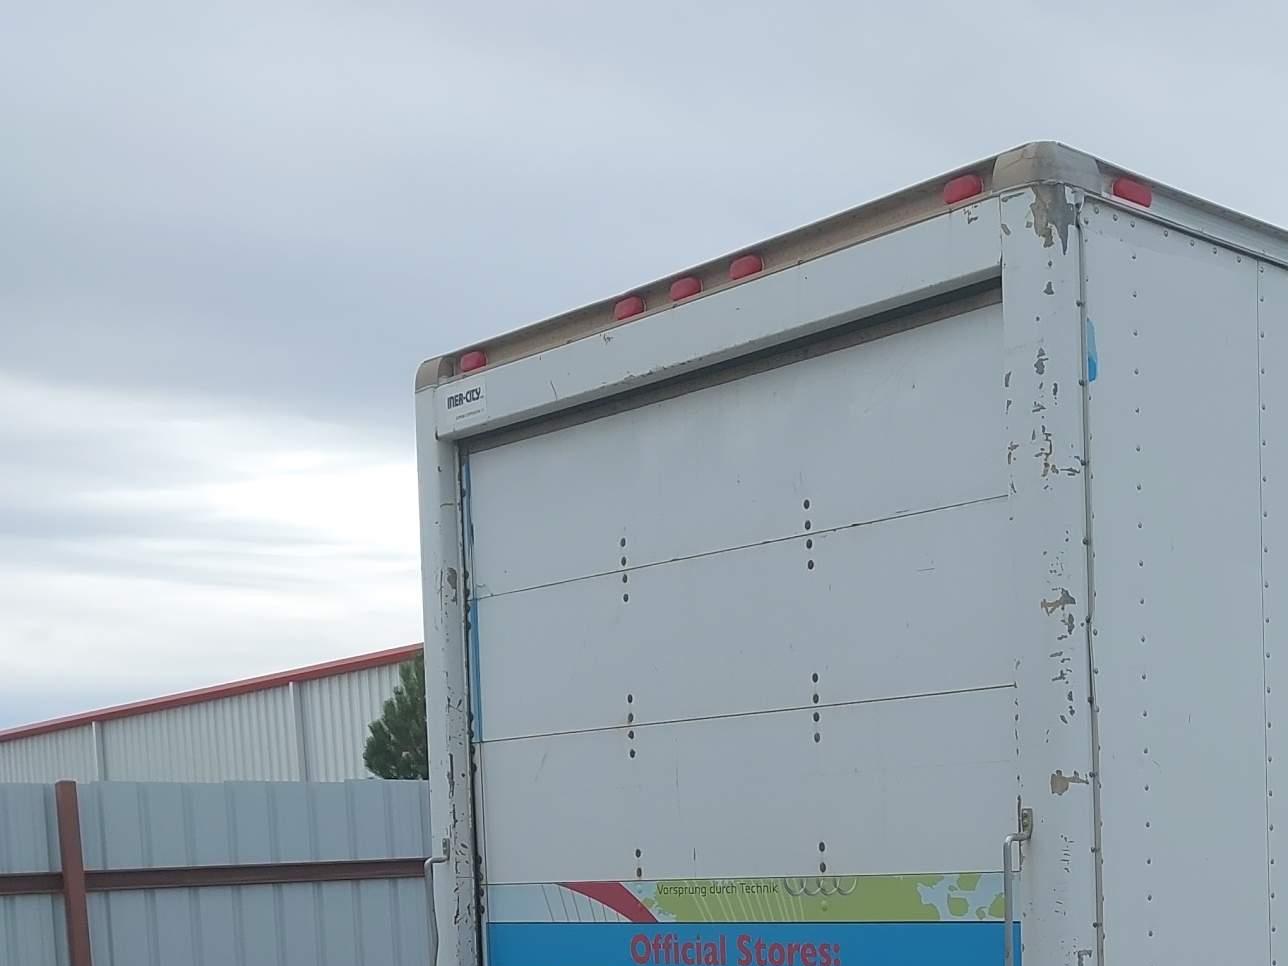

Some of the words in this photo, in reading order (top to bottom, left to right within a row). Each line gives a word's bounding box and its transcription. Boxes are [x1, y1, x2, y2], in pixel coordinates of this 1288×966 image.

[657, 884, 707, 897] Vorsprung
[710, 883, 737, 895] durch
[740, 882, 779, 895] Technik
[631, 934, 727, 966] Official
